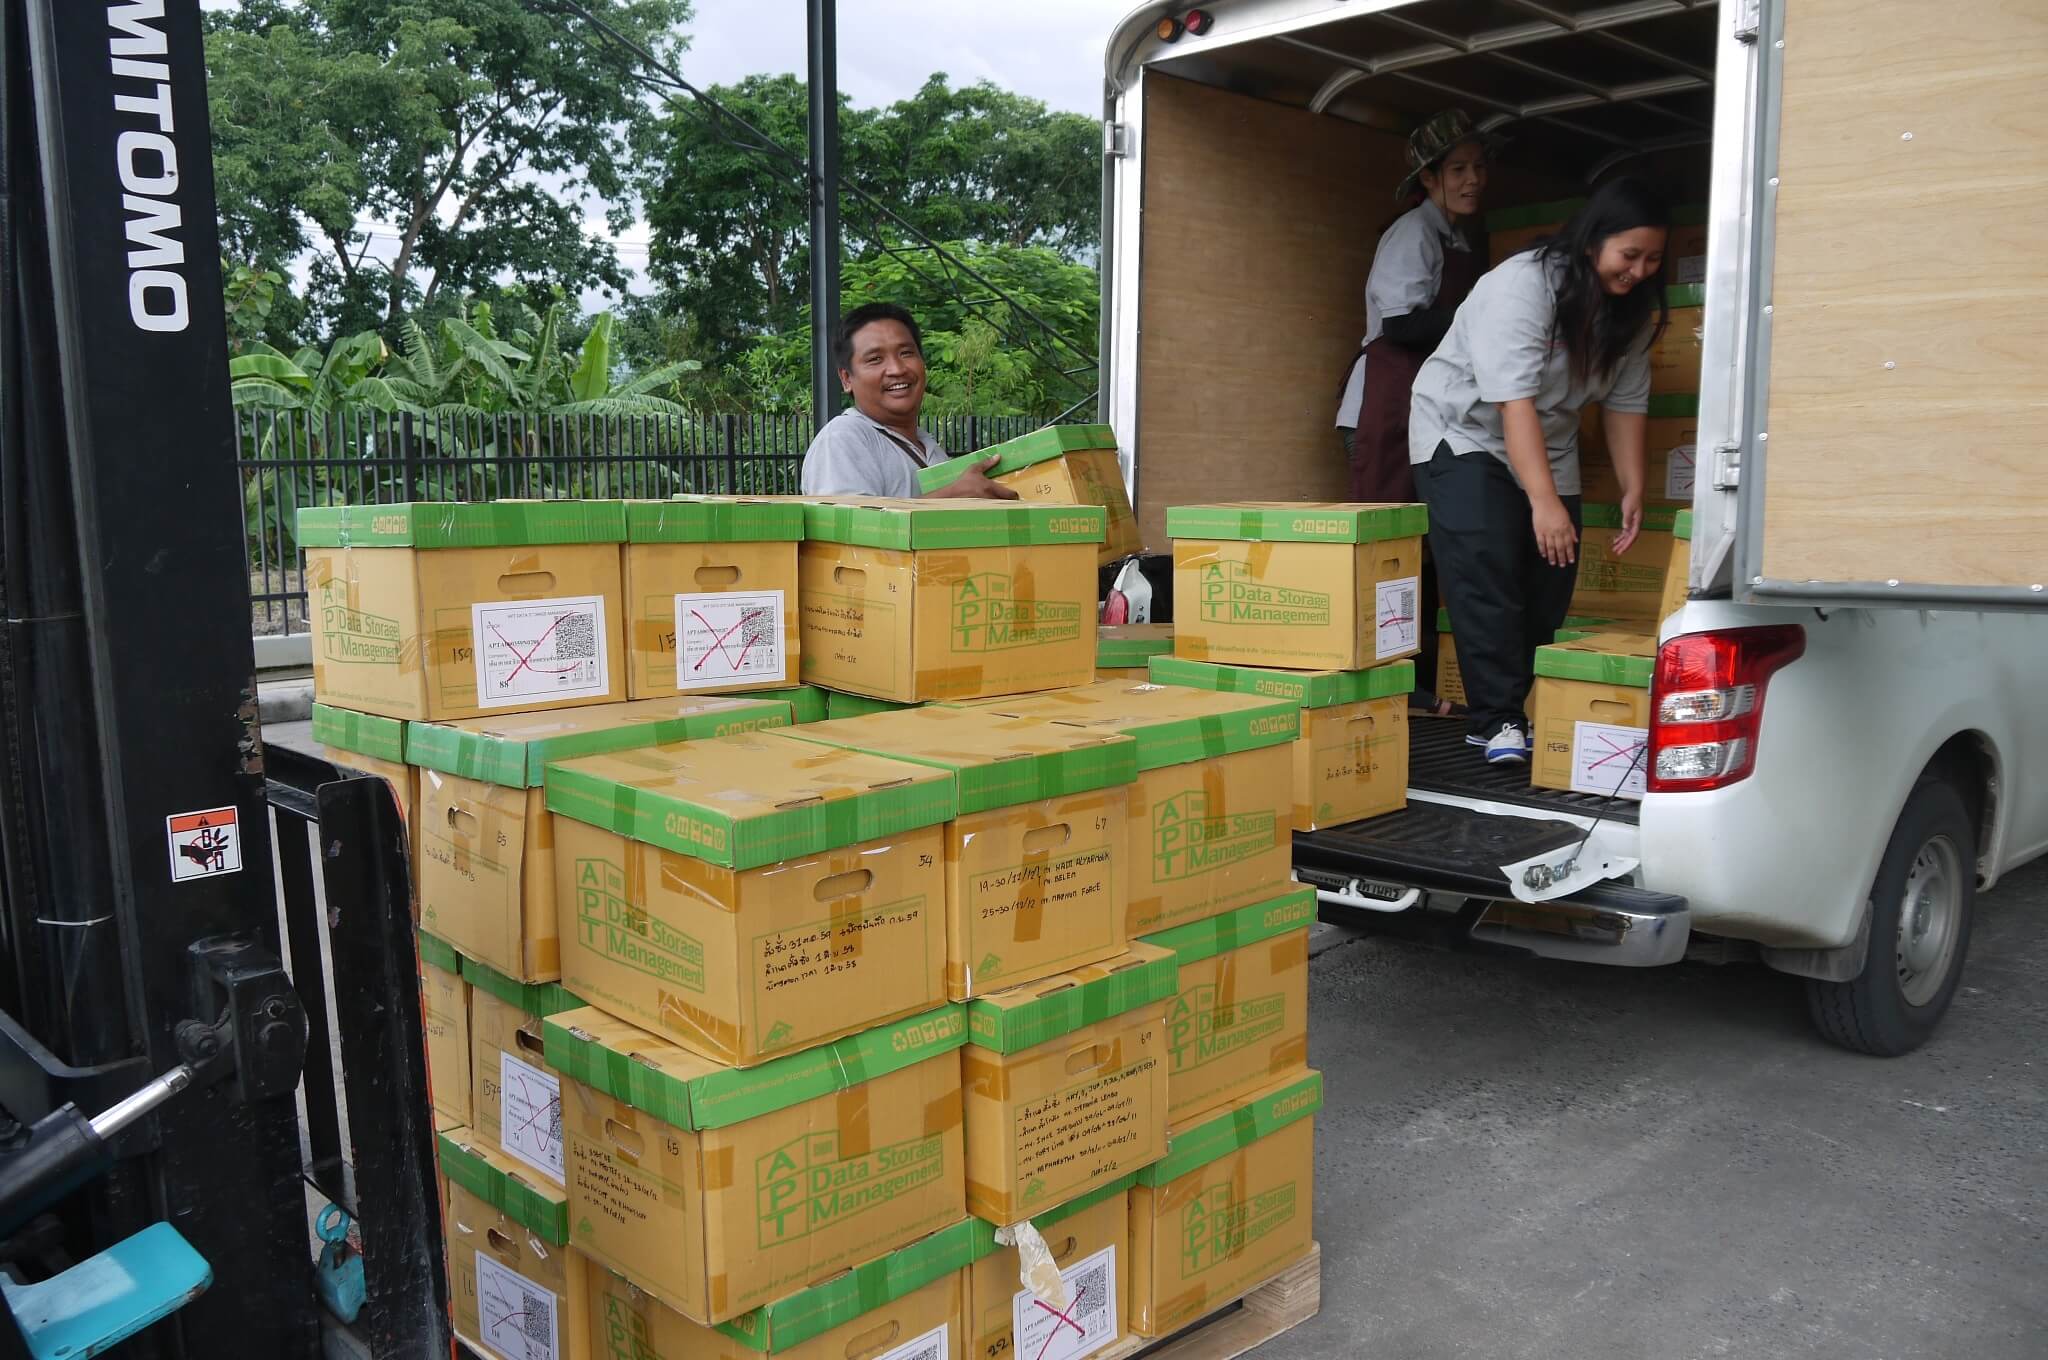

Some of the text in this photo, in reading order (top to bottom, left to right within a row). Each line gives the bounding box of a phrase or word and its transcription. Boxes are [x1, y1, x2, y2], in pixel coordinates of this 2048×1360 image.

[1035, 484, 1052, 496] 45
[1233, 584, 1328, 609] Data Storage
[990, 602, 1080, 622] Data Storage
[1233, 604, 1327, 624] Management
[338, 611, 399, 640] Data Storage
[989, 622, 1079, 645] Management
[340, 642, 402, 661] Management
[1095, 816, 1107, 831] 67
[1189, 813, 1276, 841] Data Storage
[919, 853, 933, 868] 54
[1189, 834, 1275, 867] Management
[1081, 882, 1101, 897] FORCE
[607, 899, 703, 966] Data Storage
[608, 931, 704, 990] Management
[1199, 998, 1282, 1036] Data Storage
[1199, 1018, 1282, 1059] Management
[667, 1138, 679, 1156] 65
[811, 1142, 943, 1194] Data Storage
[811, 1161, 943, 1224] Management
[1213, 1208, 1249, 1234] Data
